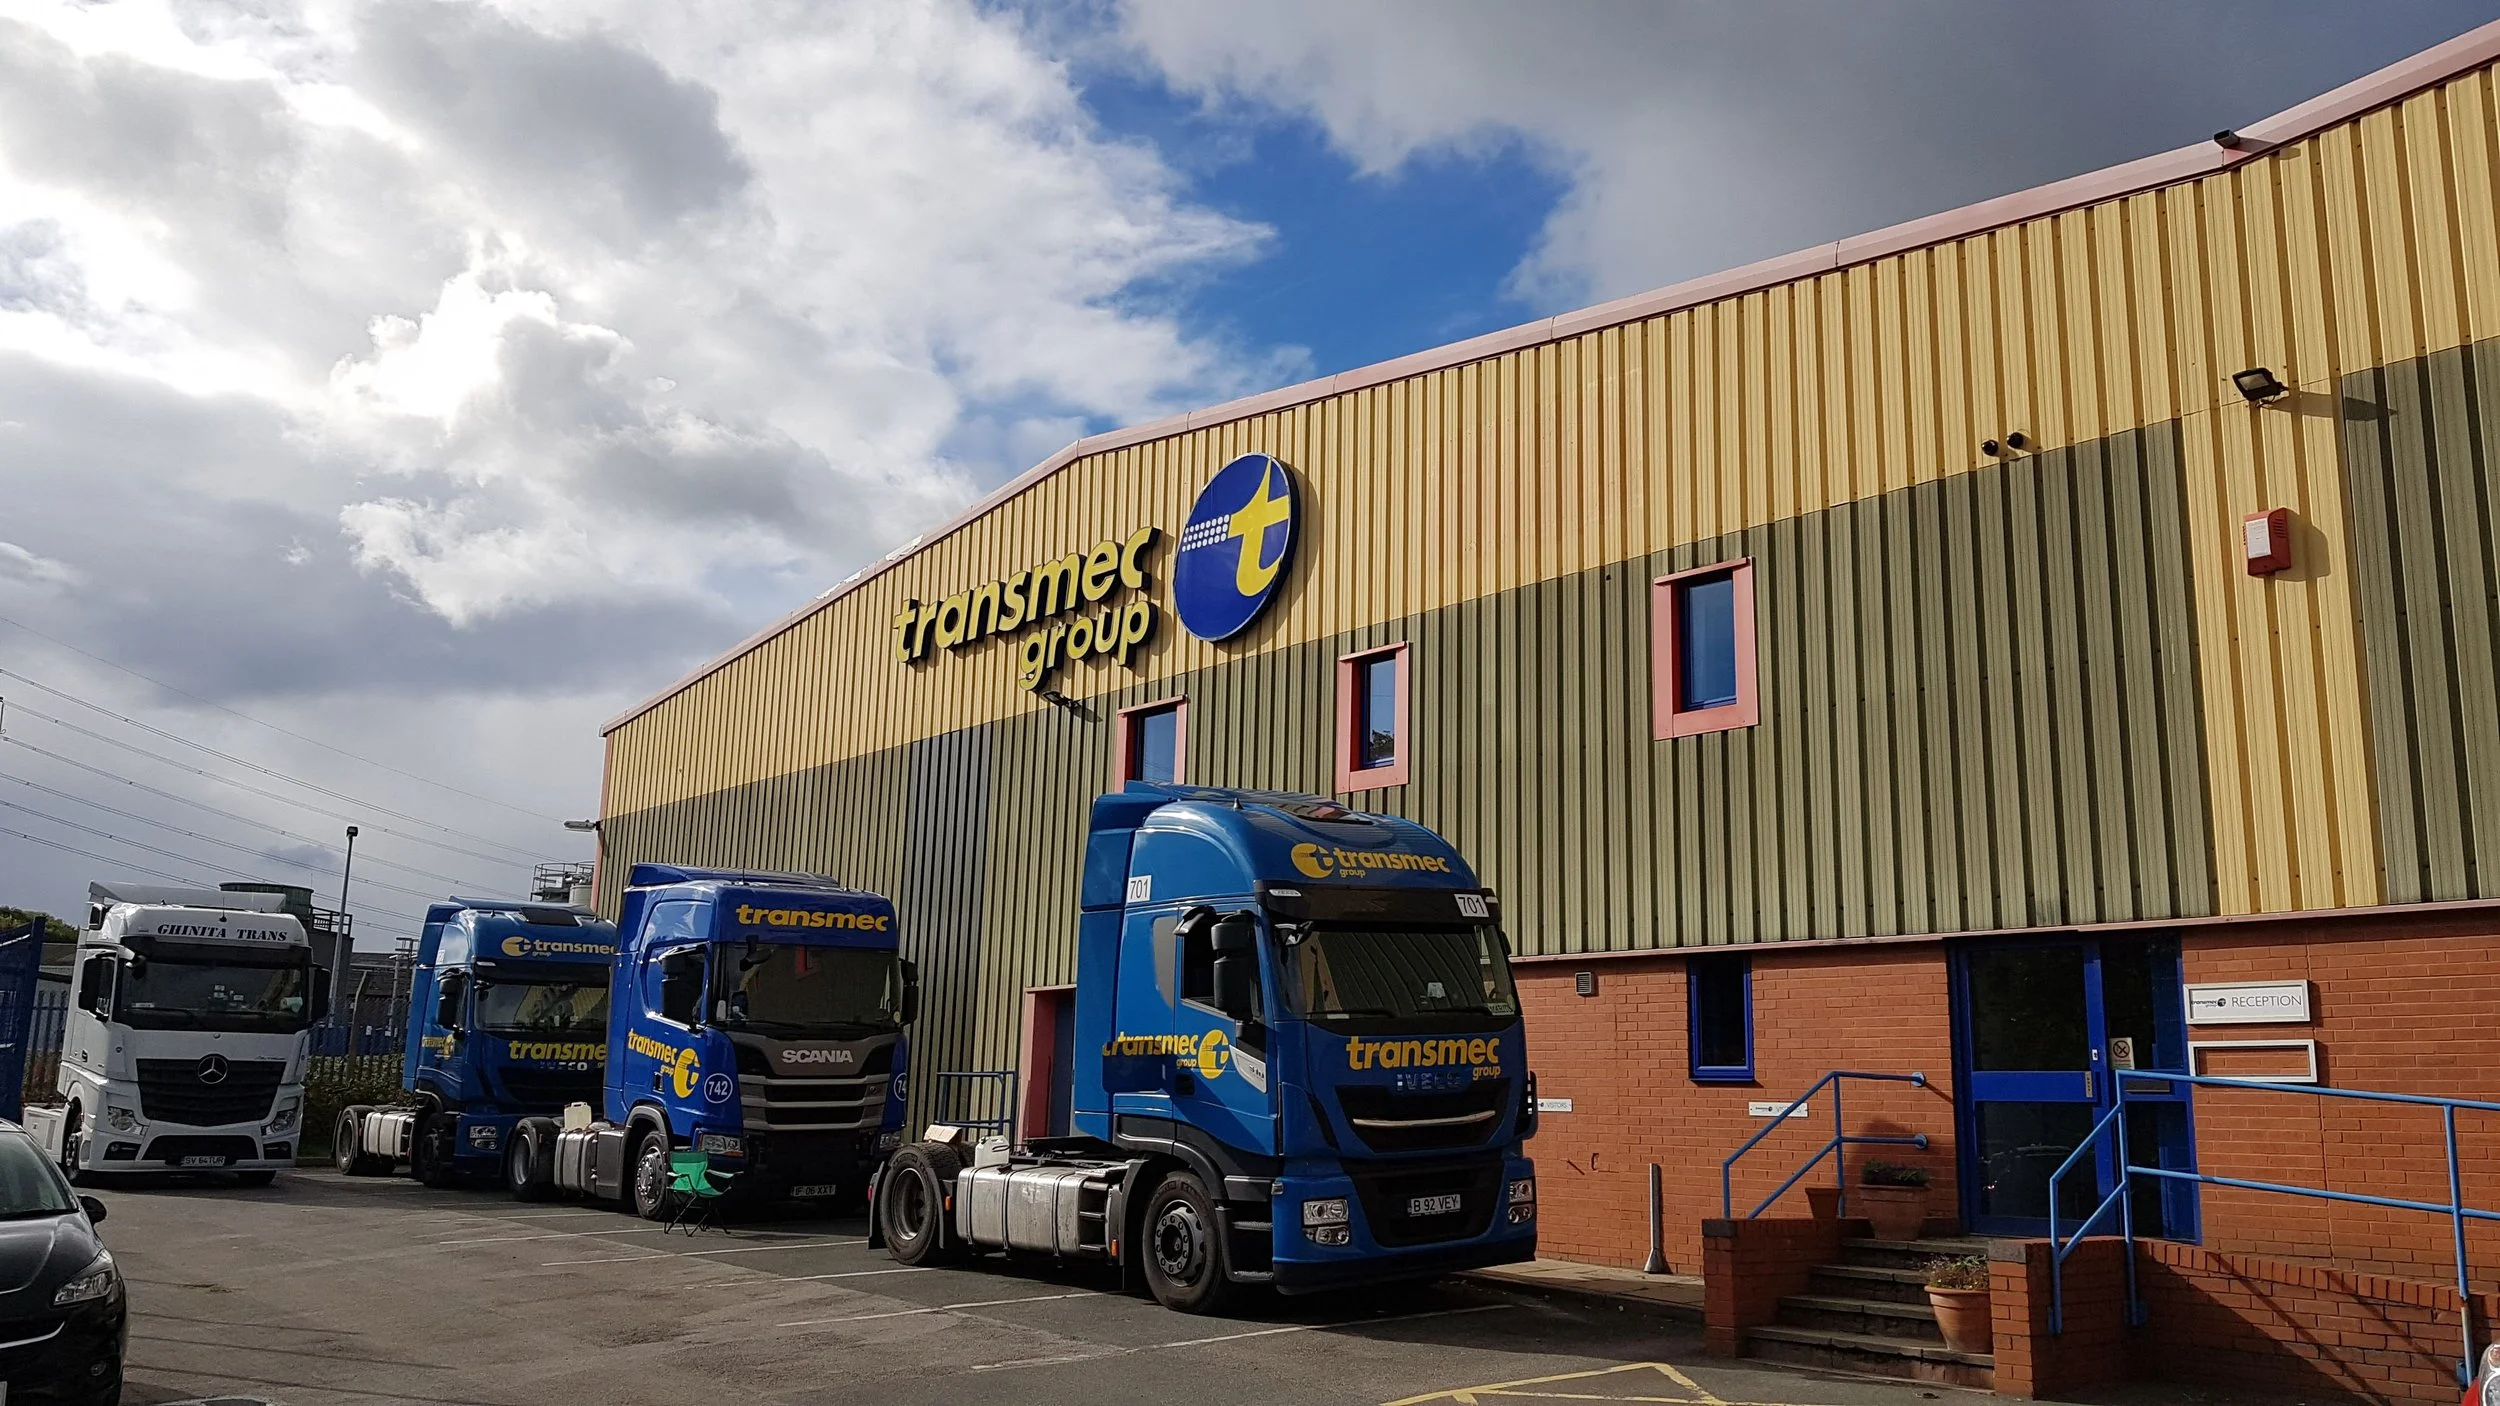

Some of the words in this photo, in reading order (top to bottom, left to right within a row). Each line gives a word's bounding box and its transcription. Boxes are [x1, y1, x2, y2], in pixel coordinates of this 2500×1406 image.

[894, 526, 1161, 663] transmec
[1019, 601, 1158, 692] group
[1334, 847, 1451, 873] transmec
[1339, 868, 1366, 879] group
[1130, 879, 1149, 900] 701
[1458, 896, 1485, 915] 701
[736, 904, 889, 931] transmec
[157, 924, 226, 938] GHINITA
[236, 929, 288, 941] TRANS
[2231, 995, 2302, 1008] RECEPTION
[508, 1040, 607, 1061] transme
[628, 1027, 678, 1065] transmec
[1101, 1031, 1199, 1056] transmec
[1345, 1035, 1500, 1070] transmec
[782, 1049, 854, 1063] SCANIA
[1176, 1058, 1198, 1069] group
[1472, 1065, 1501, 1081] group
[708, 1080, 729, 1096] 742
[898, 1079, 907, 1094] 74
[1413, 1199, 1421, 1212] B
[1424, 1198, 1436, 1211] 92
[1438, 1195, 1457, 1209] VEY
